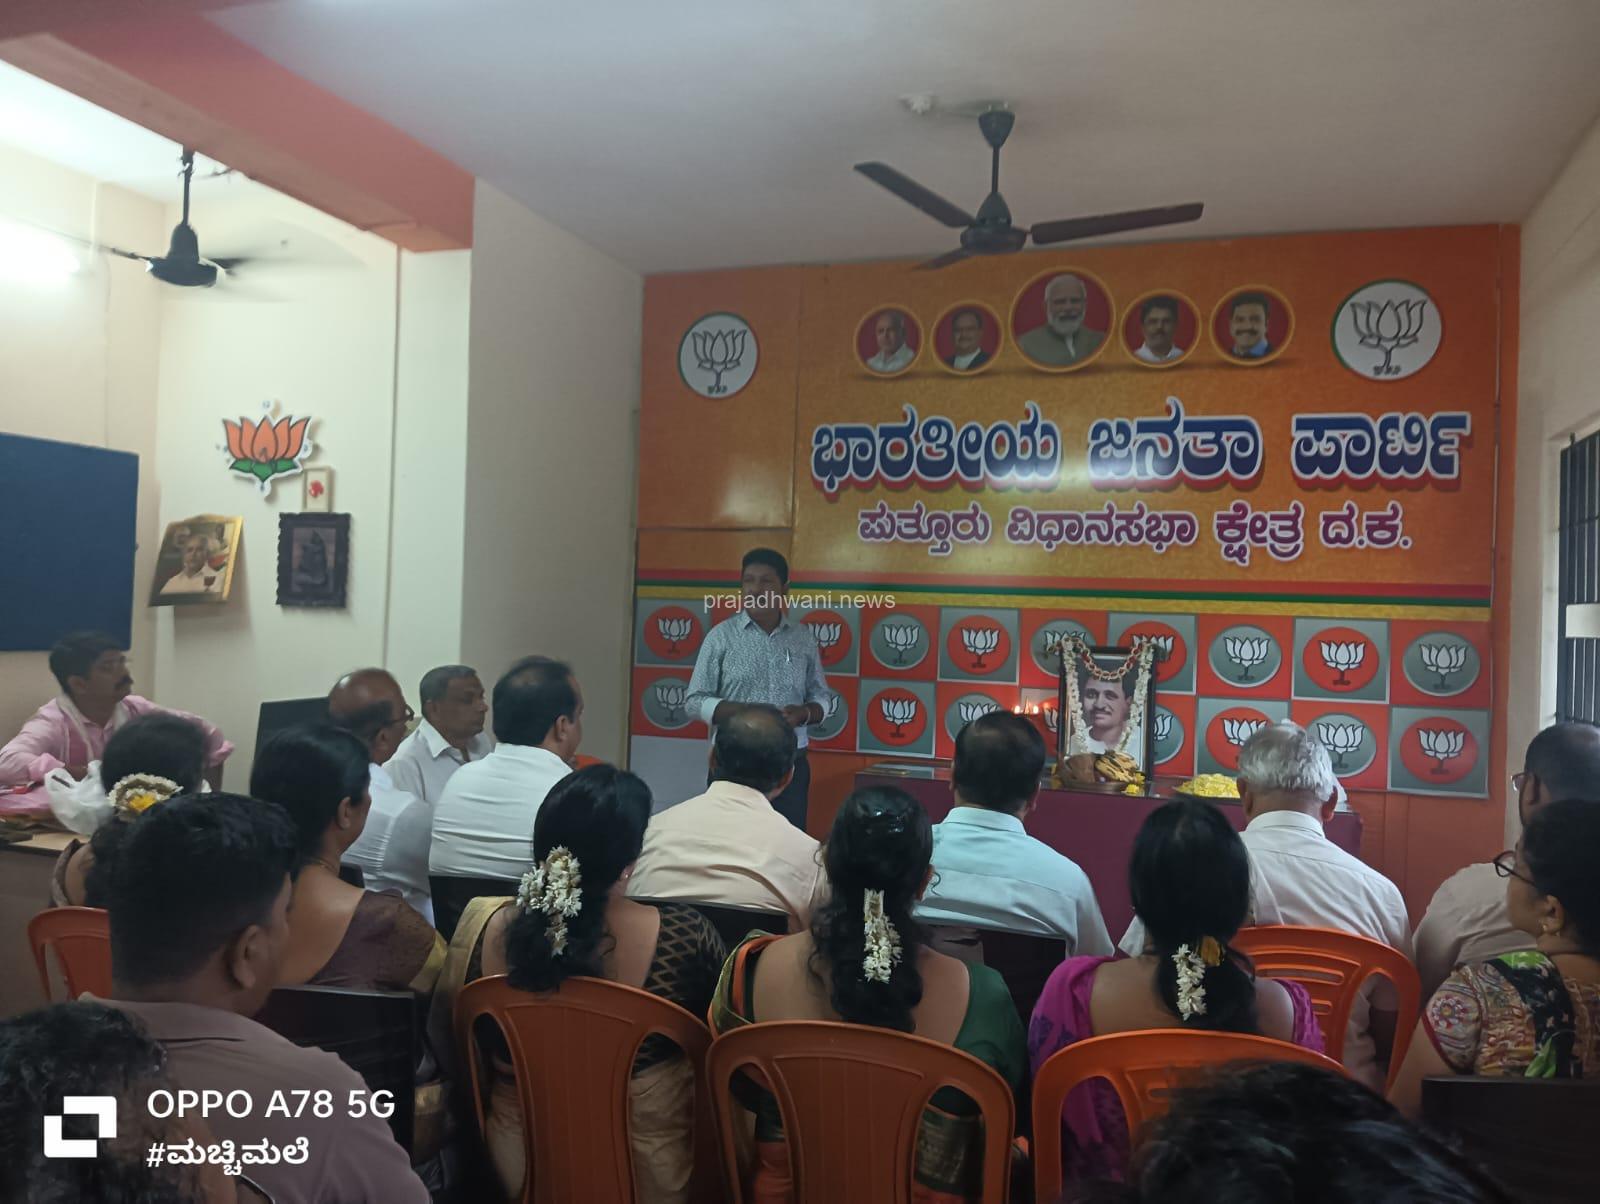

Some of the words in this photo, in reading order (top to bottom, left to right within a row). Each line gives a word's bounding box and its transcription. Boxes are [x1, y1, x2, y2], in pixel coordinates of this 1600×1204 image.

[811, 400, 1061, 492] ಭಾರತೀಯ
[1089, 397, 1263, 482] ಜನತಾ
[1291, 411, 1471, 482] ಪಾರ್ಟಿ
[858, 500, 991, 556] ಪುತ್ತೂರು
[1006, 500, 1199, 552] ವಿಧಾನಸಭಾ
[1214, 500, 1304, 567] ಕ್ಷೇತ್ರ
[1318, 500, 1412, 549] ದ.ಕ.
